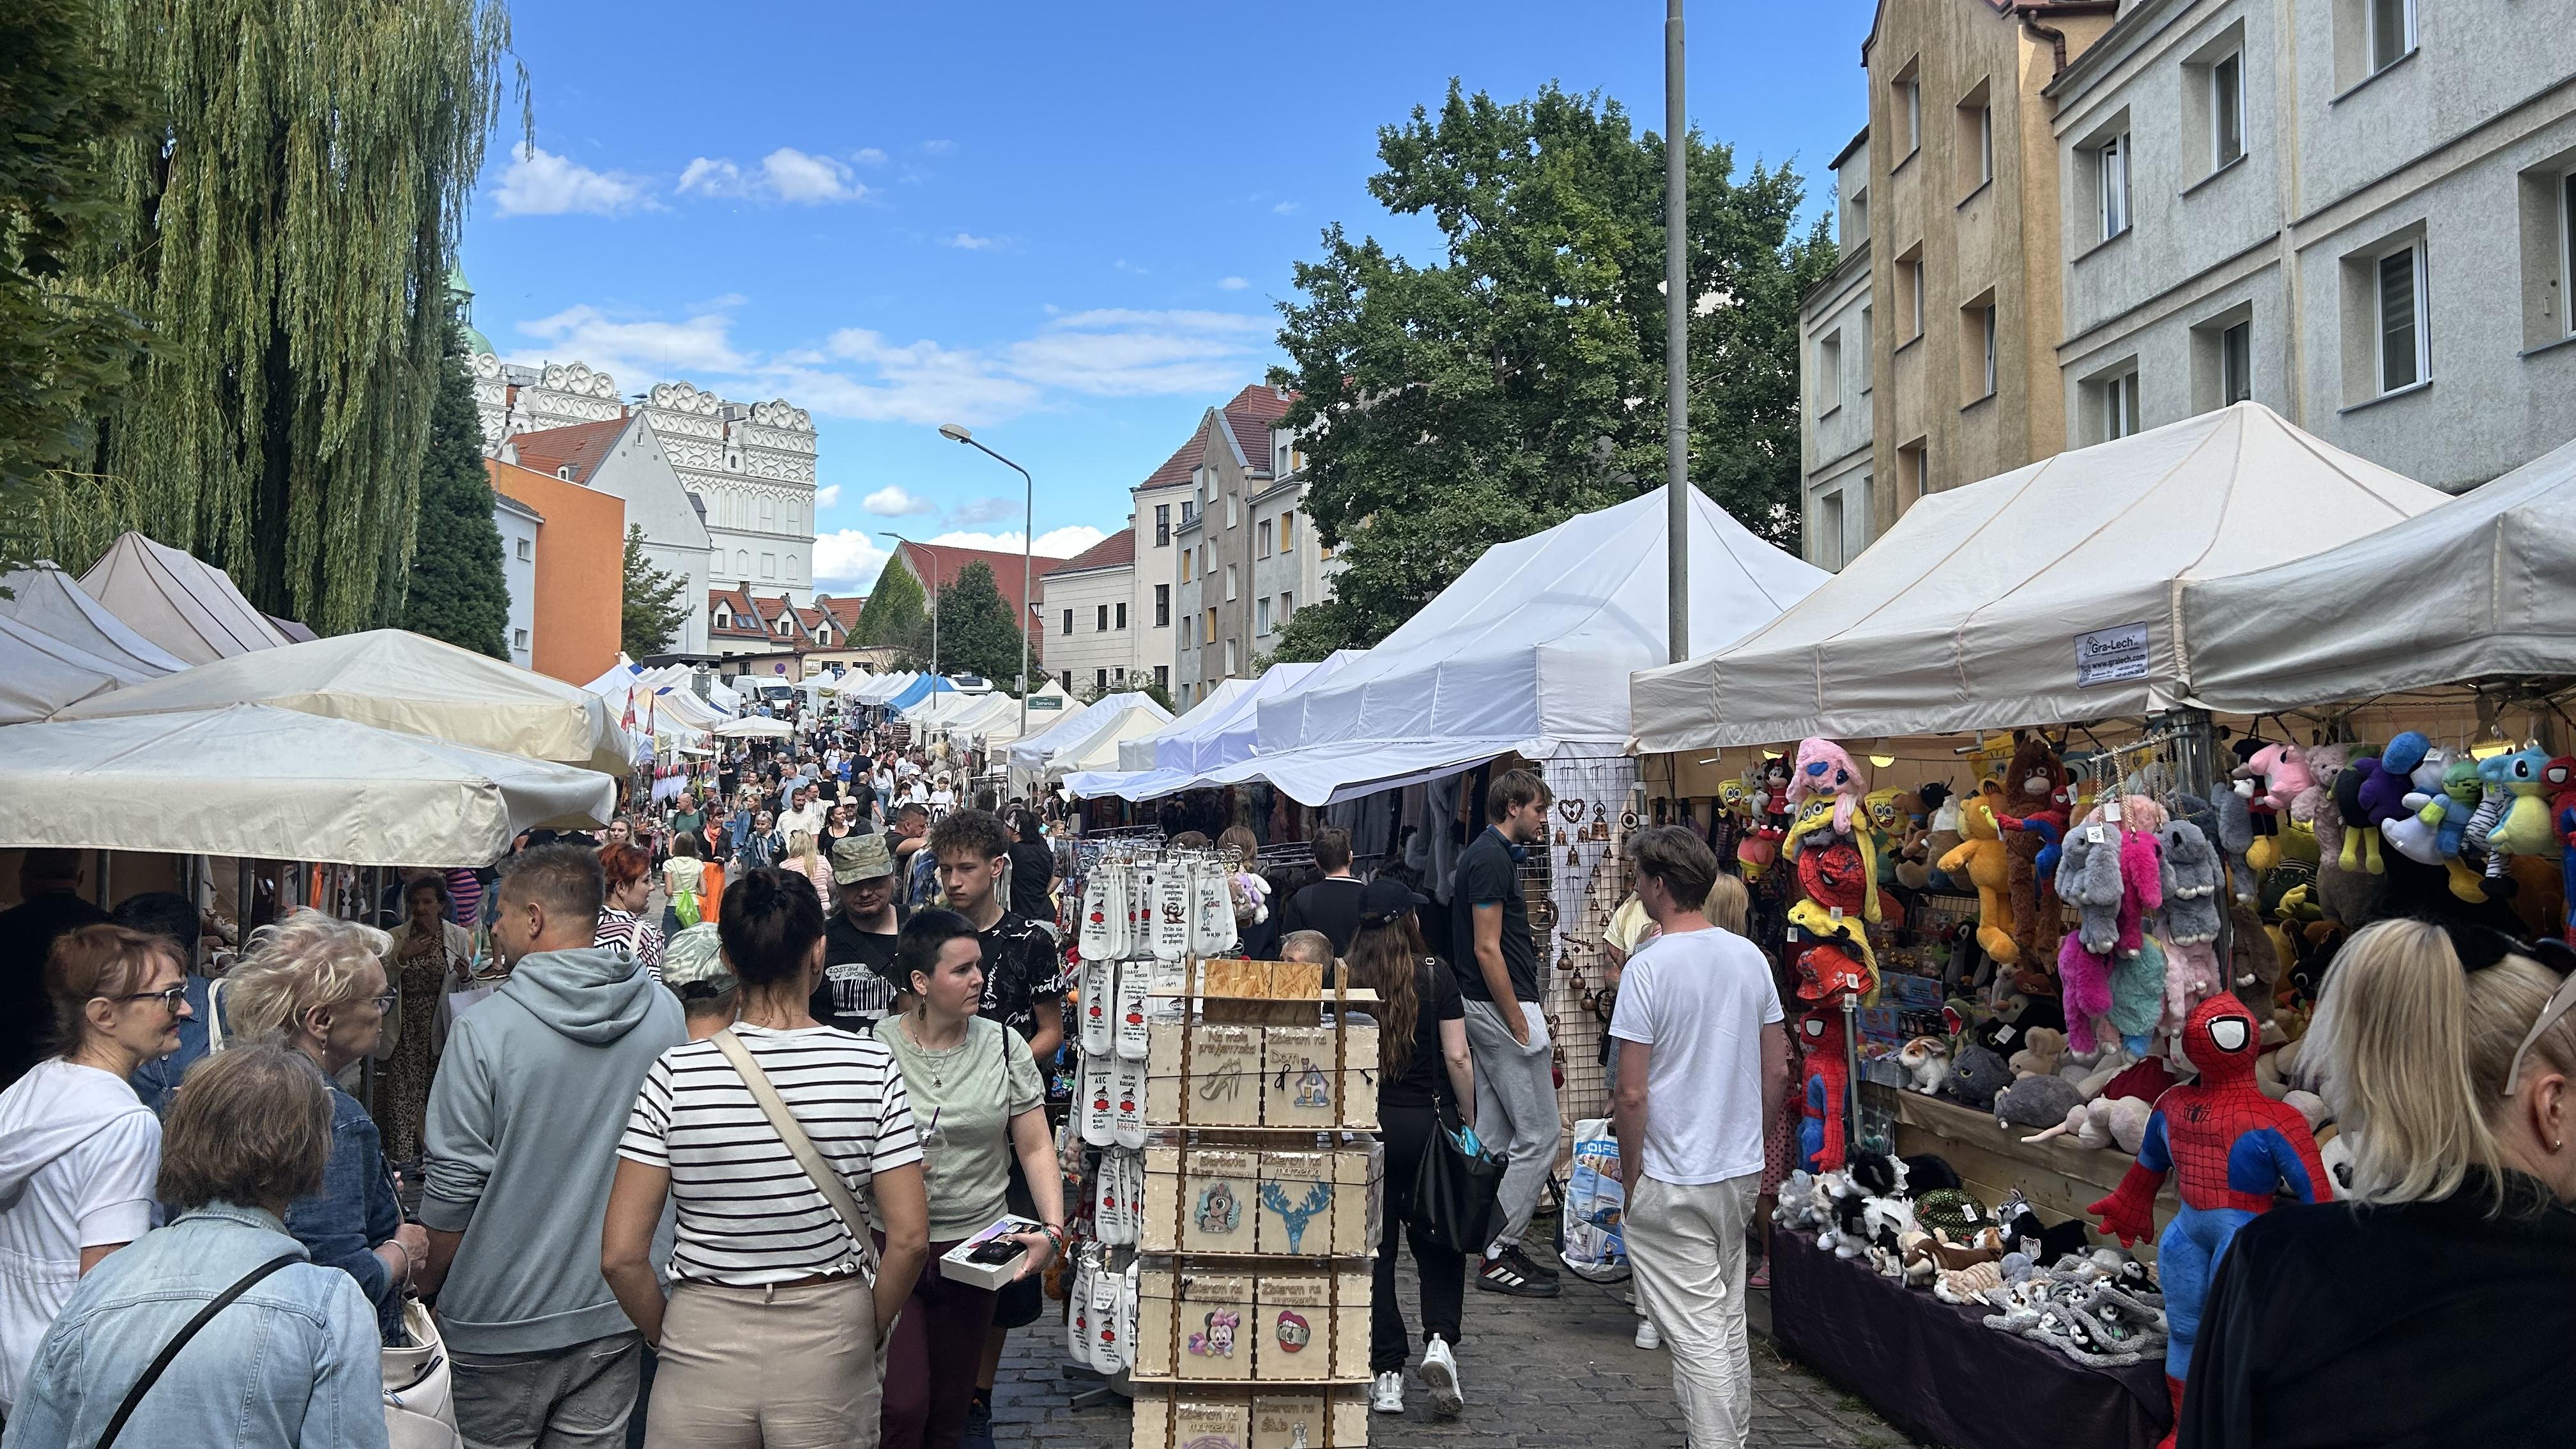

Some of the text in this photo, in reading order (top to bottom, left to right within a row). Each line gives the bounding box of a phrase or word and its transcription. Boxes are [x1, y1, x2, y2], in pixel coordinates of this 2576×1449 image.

[2092, 637, 2133, 653] Gra-Lech
[2092, 654, 2145, 668] www.gralech.com
[1208, 1032, 1223, 1043] Na
[1268, 1032, 1327, 1046] Zbieram na
[1270, 1049, 1300, 1064] Dom
[1579, 1142, 1619, 1155] POLFE
[1262, 1154, 1321, 1167] Zbieram na
[1274, 1166, 1321, 1177] marzenia
[1186, 1283, 1243, 1294] Zbieram na
[1262, 1283, 1322, 1295] Zbieram na
[1271, 1295, 1319, 1306] marzenia
[1255, 1402, 1315, 1414] Zbieram na
[1178, 1409, 1239, 1421] Zbieram na
[1188, 1422, 1236, 1433] marzenia
[1261, 1415, 1289, 1433] Ślub
